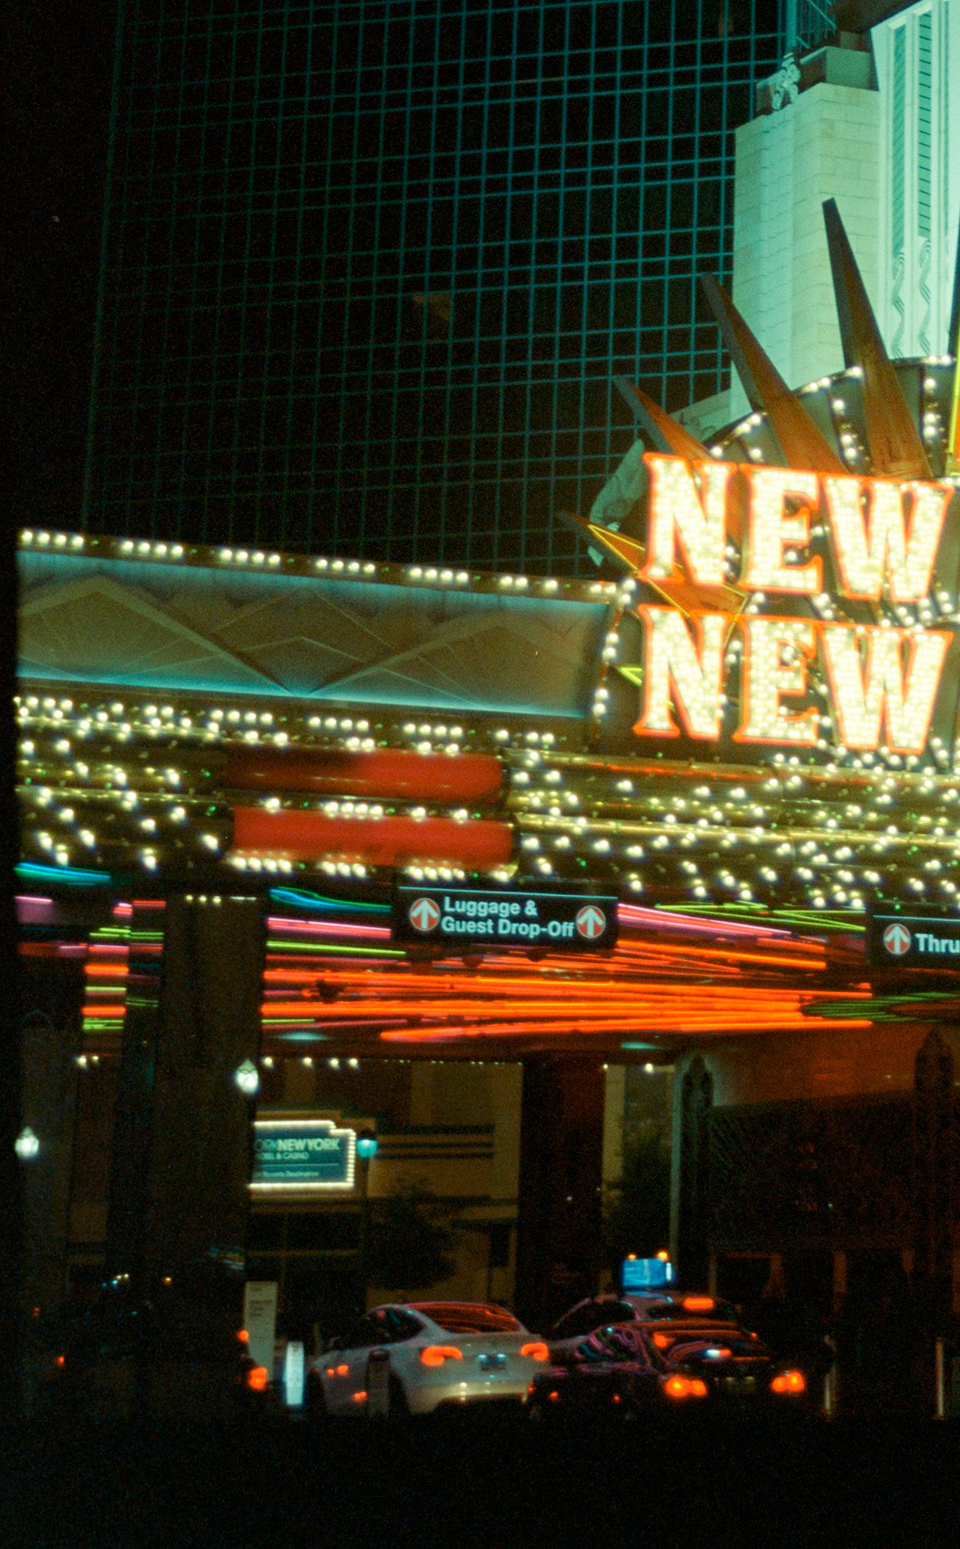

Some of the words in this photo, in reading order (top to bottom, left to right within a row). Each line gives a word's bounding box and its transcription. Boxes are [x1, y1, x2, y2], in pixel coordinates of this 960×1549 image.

[639, 452, 955, 603] NEW
[633, 603, 954, 754] NEW
[444, 896, 520, 917] Luggage
[524, 899, 538, 916] &
[441, 917, 494, 934] Guest
[498, 919, 575, 938] Drop-Off
[915, 933, 960, 953] Thru
[277, 1138, 306, 1151] NEW
[307, 1137, 340, 1151] YORK
